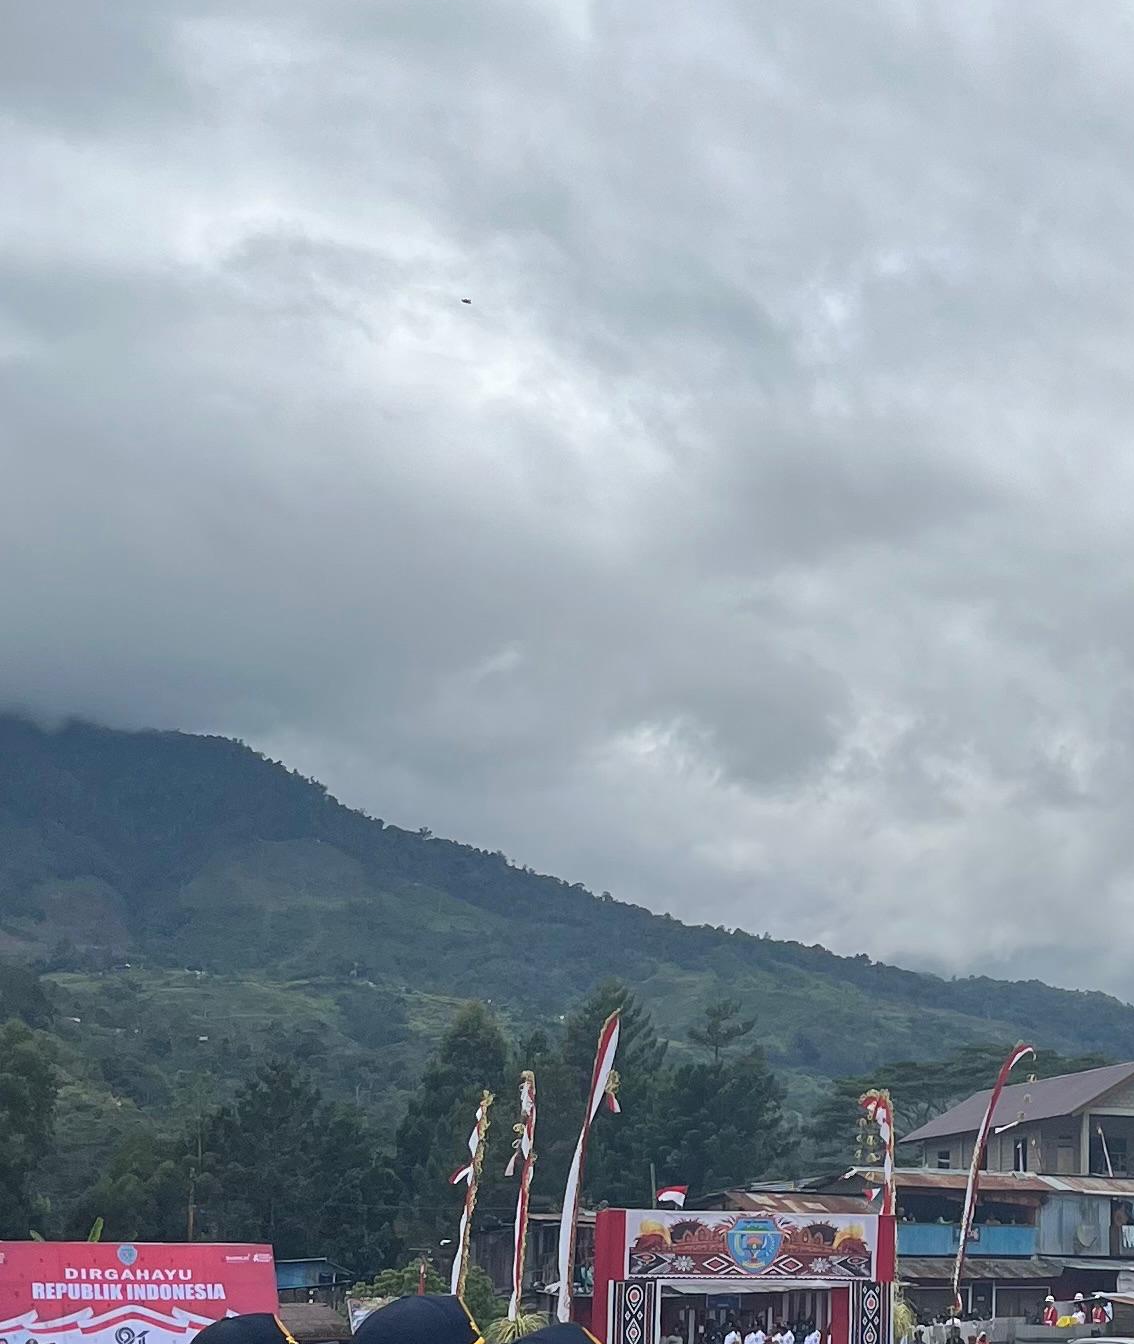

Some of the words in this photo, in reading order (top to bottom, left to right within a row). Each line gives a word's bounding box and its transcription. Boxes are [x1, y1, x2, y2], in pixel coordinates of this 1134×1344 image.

[64, 1267, 192, 1280] DIRGAHAYU
[32, 1282, 123, 1300] REPUBLIK
[126, 1283, 226, 1300] INDONESIA
